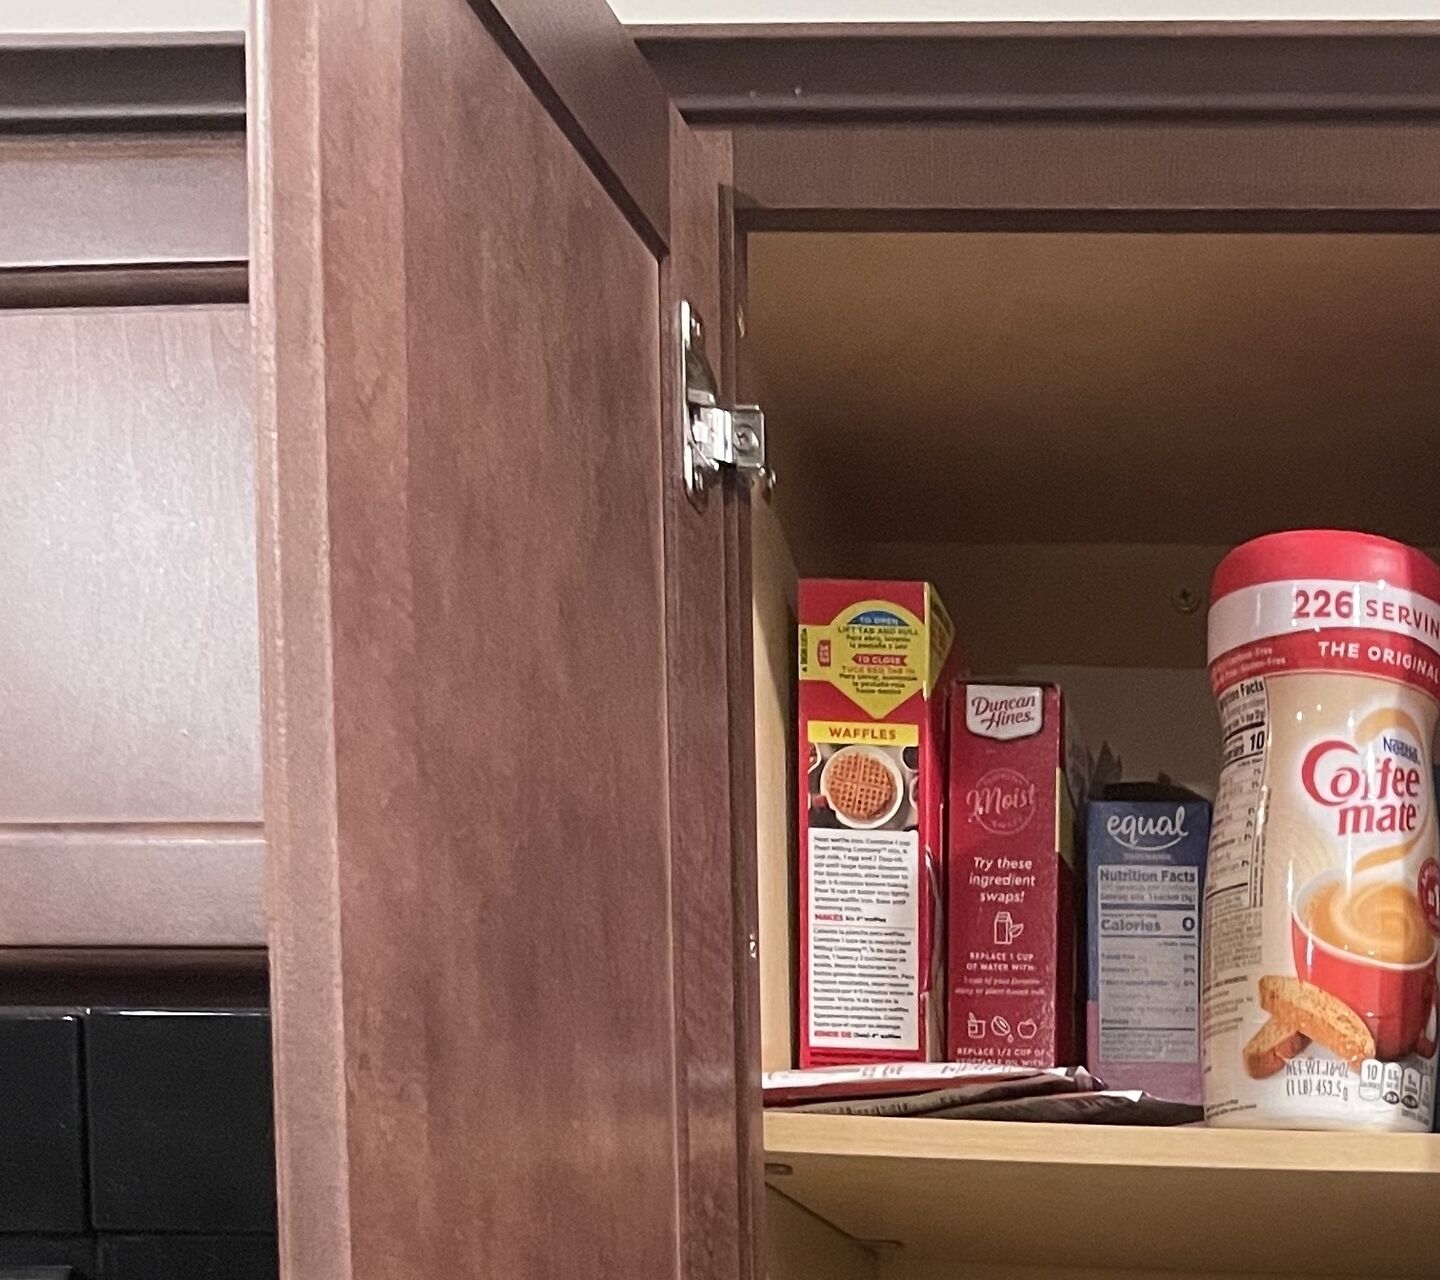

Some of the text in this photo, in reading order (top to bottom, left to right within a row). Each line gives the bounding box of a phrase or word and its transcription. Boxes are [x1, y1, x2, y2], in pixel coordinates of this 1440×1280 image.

[1293, 590, 1354, 619] 226
[858, 655, 902, 665] TO CLOSE
[1318, 642, 1440, 684] THE ORIGINAL
[971, 695, 1036, 717] Duncan
[829, 726, 896, 740] WAFFLES
[1250, 731, 1265, 751] 10
[966, 783, 1036, 822] Moist
[1107, 805, 1189, 847] equal
[1338, 802, 1417, 836] mate
[973, 857, 1032, 870] Try these
[969, 873, 1036, 888] ingredient
[1100, 869, 1196, 882] Nutrition Facts
[980, 890, 1025, 904] swaps!
[1101, 917, 1195, 932] Calories 0
[969, 952, 1007, 961] REPLACE
[1016, 953, 1034, 961] CUP
[966, 963, 978, 971] OF
[980, 963, 1009, 971] WATER
[957, 1048, 994, 1056] REPLACE
[1366, 1064, 1378, 1080] 10
